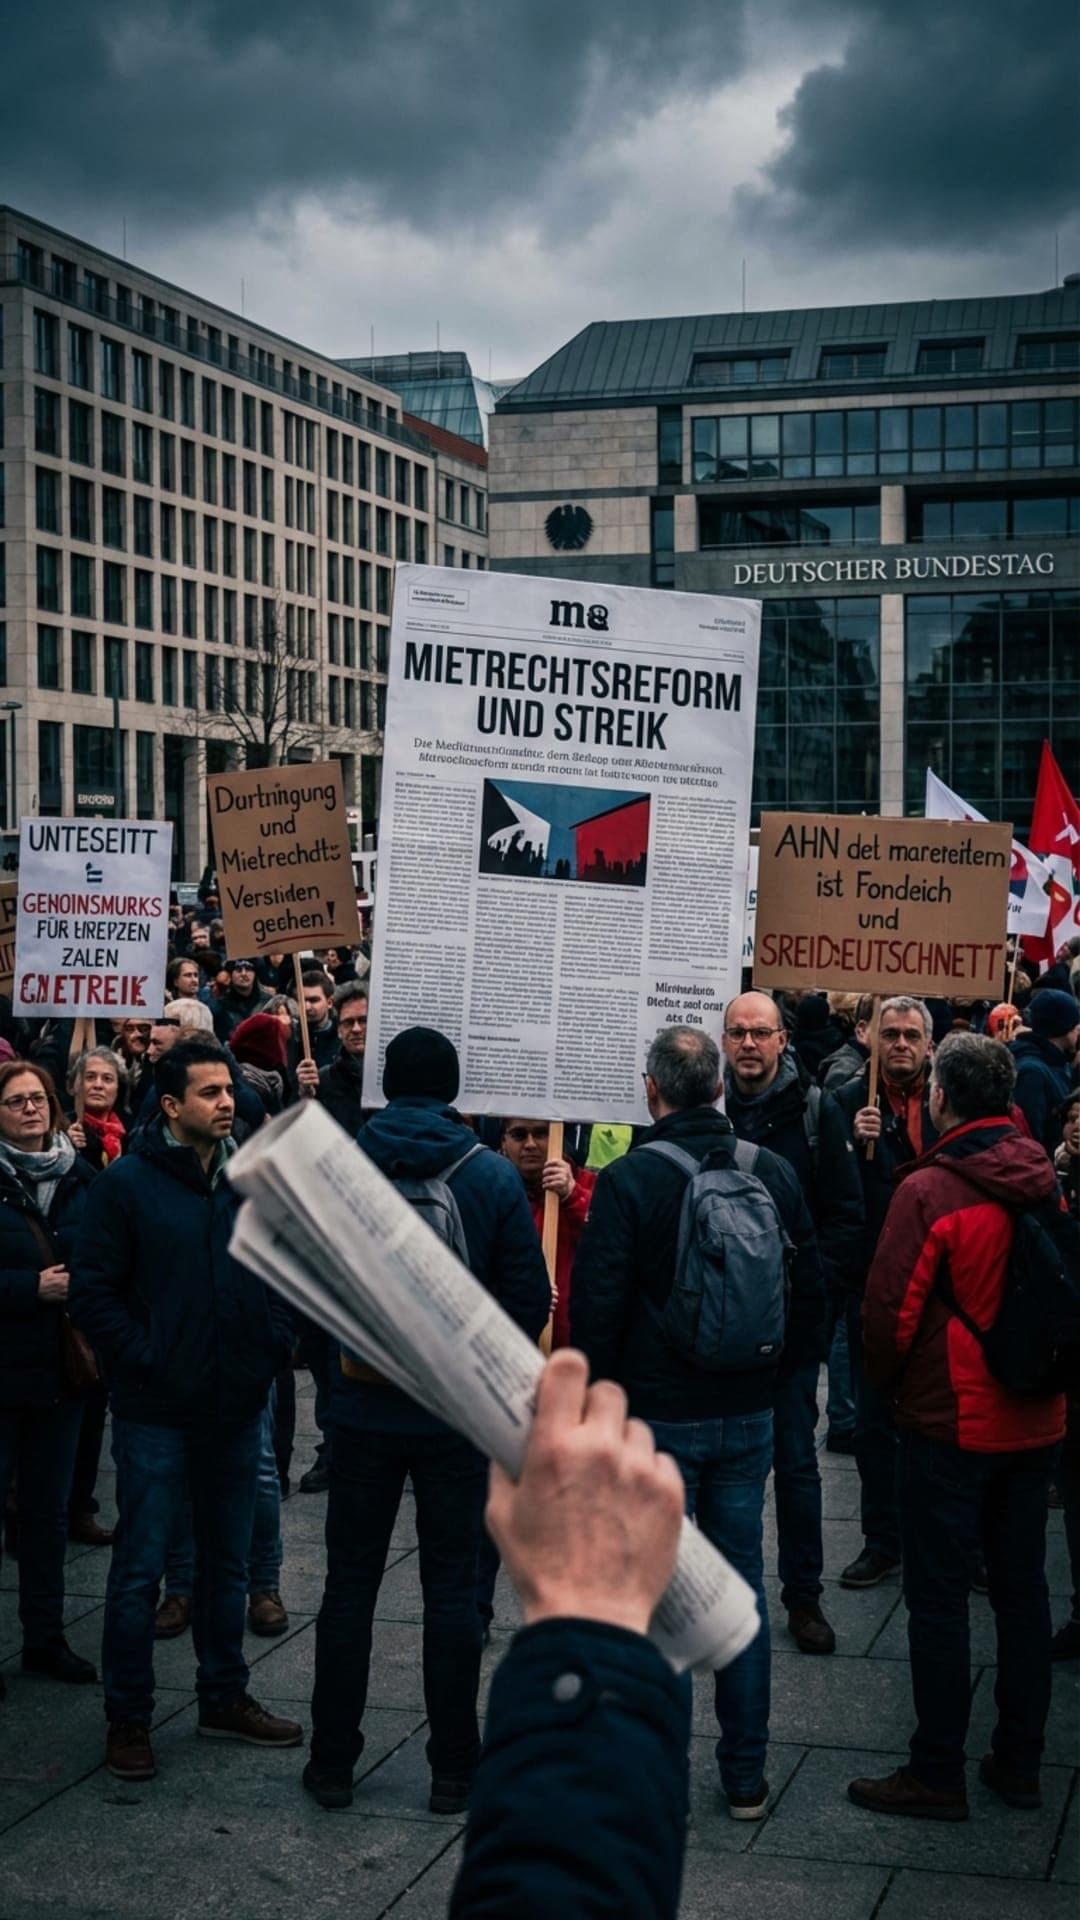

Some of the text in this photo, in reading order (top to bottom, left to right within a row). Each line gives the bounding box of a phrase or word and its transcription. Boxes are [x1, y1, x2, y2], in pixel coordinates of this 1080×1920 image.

[734, 552, 1055, 584] DEUTSCHER BUNDESTAG
[403, 641, 742, 712] MIETRECHTSREFORM
[476, 695, 544, 738] UND
[553, 702, 669, 750] STREIK
[29, 824, 158, 854] UNTESEITT
[260, 814, 297, 837] und
[774, 824, 840, 860] AHN
[816, 870, 952, 903] ist Fondeich
[858, 907, 899, 930] und
[61, 947, 119, 968] ZALEN
